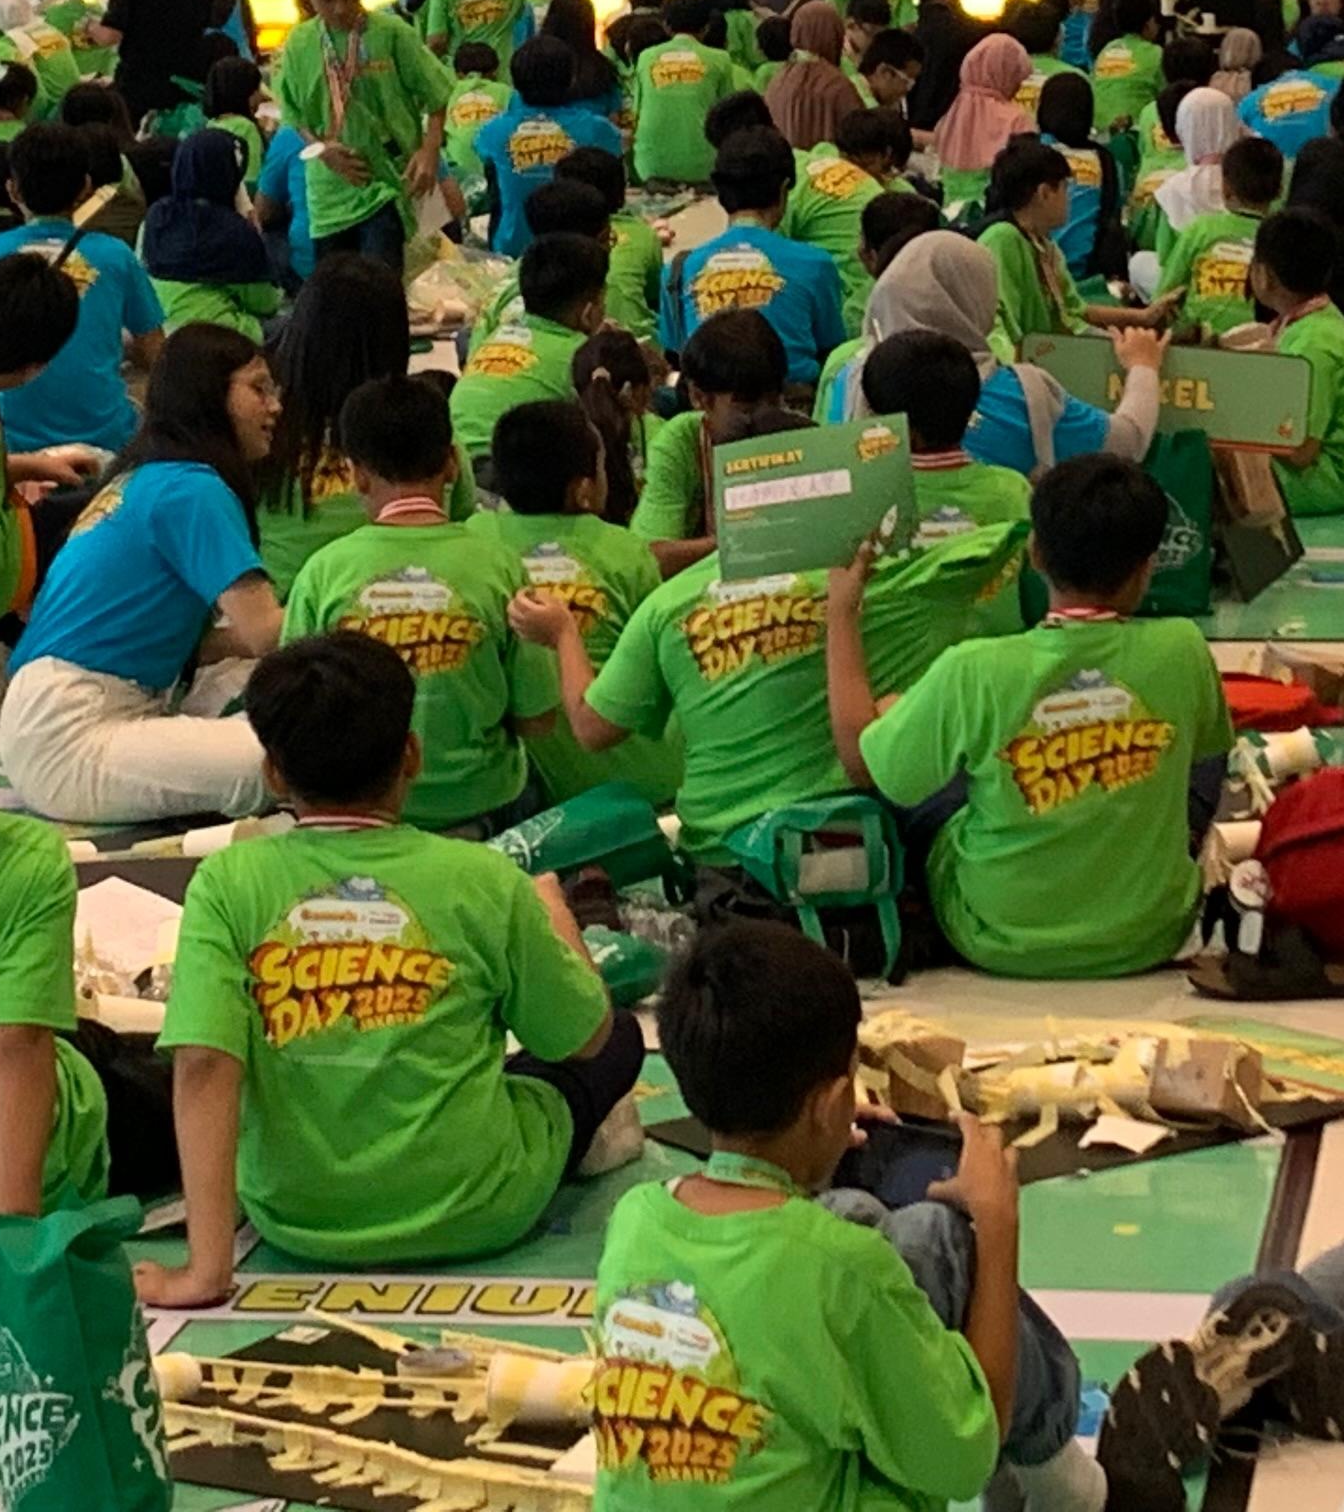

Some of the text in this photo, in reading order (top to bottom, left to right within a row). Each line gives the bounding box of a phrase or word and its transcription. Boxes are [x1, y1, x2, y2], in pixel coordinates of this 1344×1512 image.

[1014, 722, 1173, 784] SCIENCE
[1030, 769, 1098, 816] DAY
[256, 943, 455, 1005] SCIENCE
[268, 985, 430, 1049] DAY 2025
[648, 1428, 738, 1469] 2025
